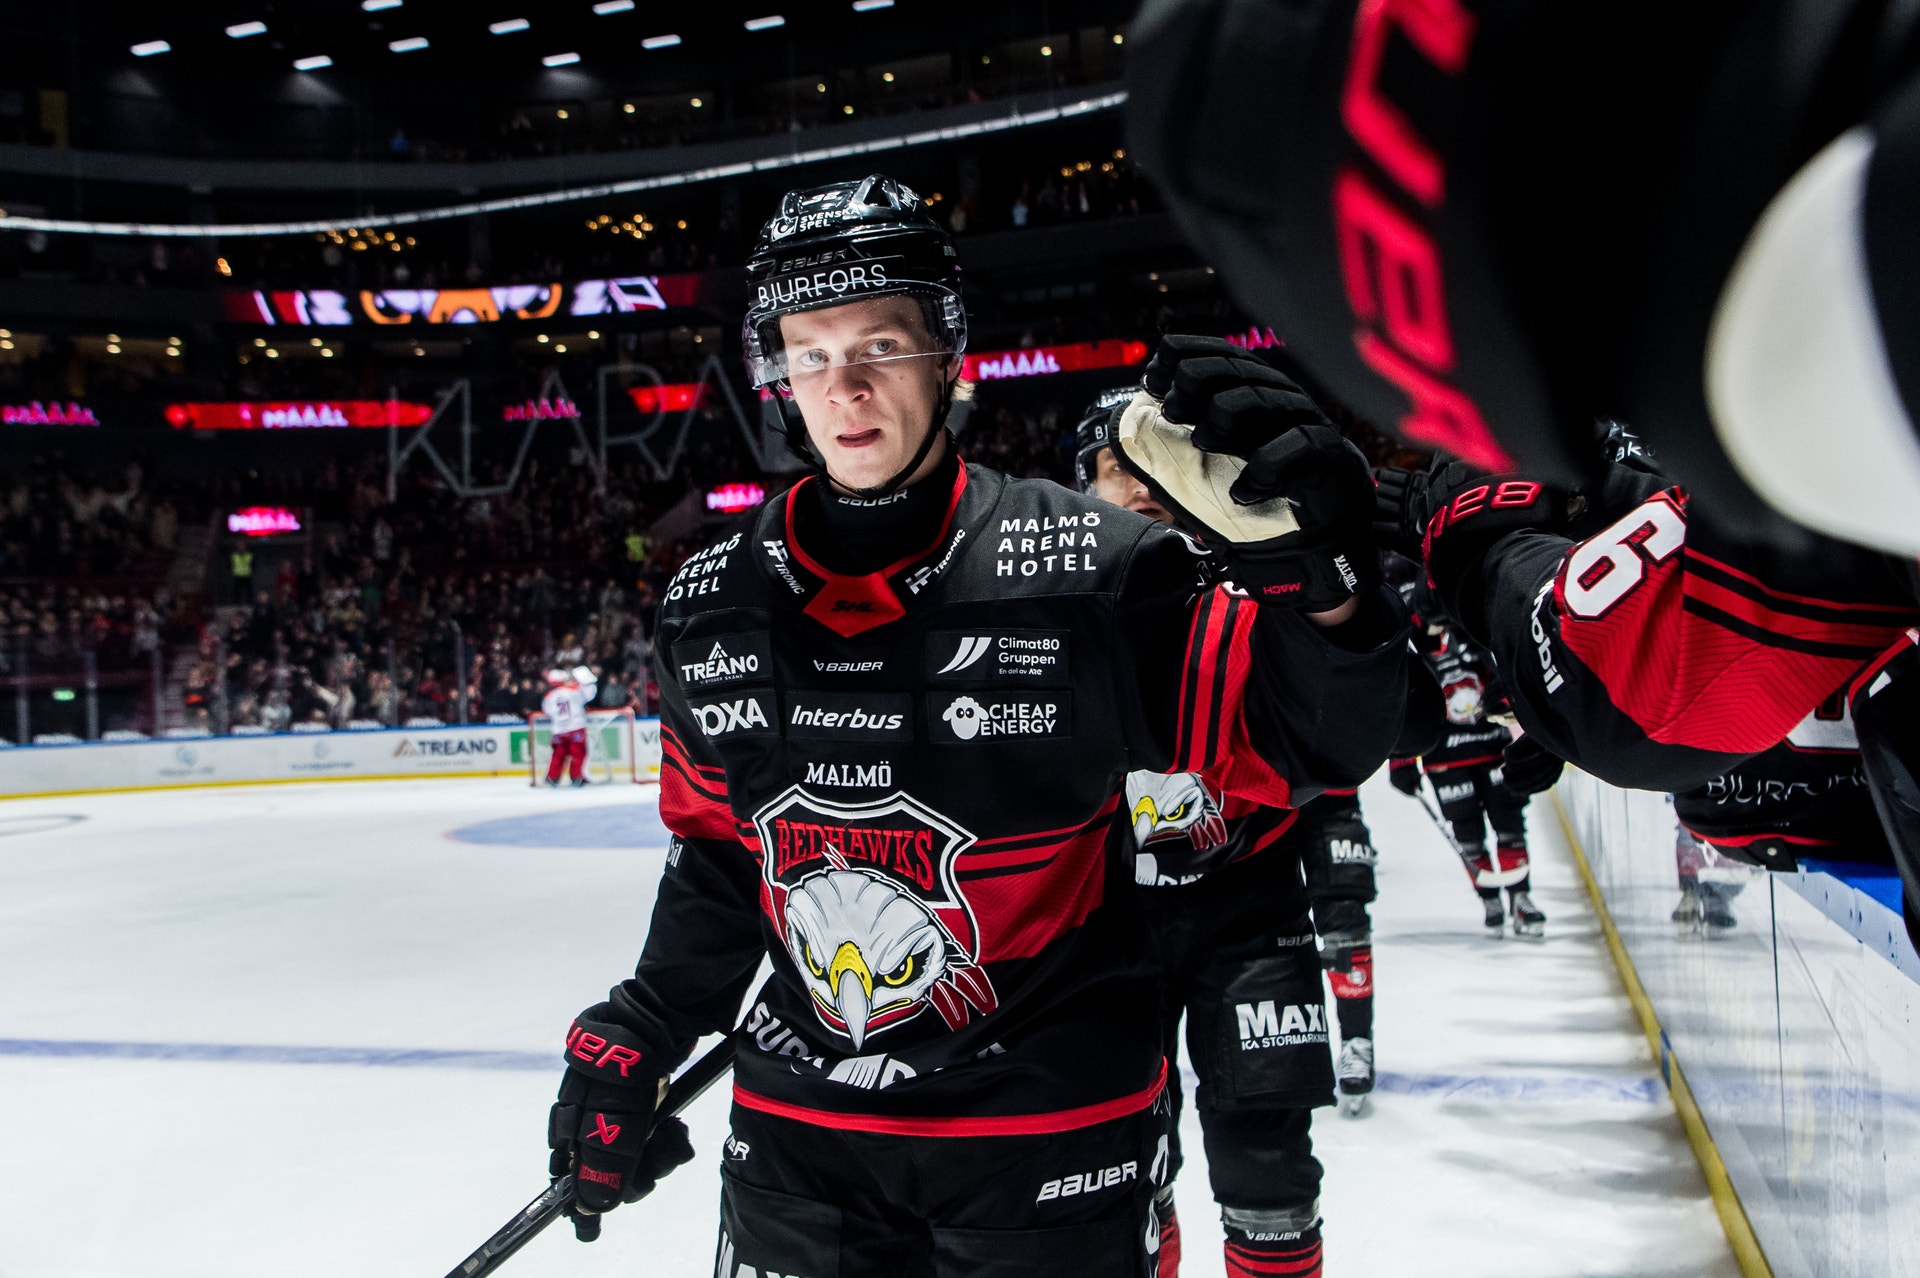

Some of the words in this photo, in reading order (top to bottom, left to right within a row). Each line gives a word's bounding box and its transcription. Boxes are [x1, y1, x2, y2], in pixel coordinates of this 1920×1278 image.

[801, 207, 861, 223] SVENSKA
[799, 217, 832, 233] SPEL
[781, 249, 848, 272] BAUER
[757, 264, 887, 310] BJURFORS
[1000, 511, 1101, 533] MALMÖ
[932, 529, 966, 575] TRONIC
[997, 532, 1098, 553] ARENA
[996, 554, 1097, 577] HOTEL
[775, 562, 805, 594] TRONIC
[1263, 582, 1302, 595] MACH
[831, 600, 876, 613] SHL
[998, 637, 1060, 651] Climat80
[681, 654, 759, 682] TREANO
[826, 661, 883, 672] BAUER
[998, 652, 1056, 666] Gruppen
[1008, 667, 1018, 675] del
[791, 705, 904, 731] Interbus
[989, 704, 1057, 720] CHEAP
[980, 719, 1057, 736] ENERGY
[417, 738, 498, 755] TREANO
[804, 761, 892, 787] MALMÖ
[776, 818, 934, 891] REDHAWKS
[1236, 1000, 1327, 1040] MAXI
[1241, 1040, 1260, 1051] ICA
[1036, 1161, 1138, 1204] BAUER
[1254, 1231, 1301, 1242] BAUER
